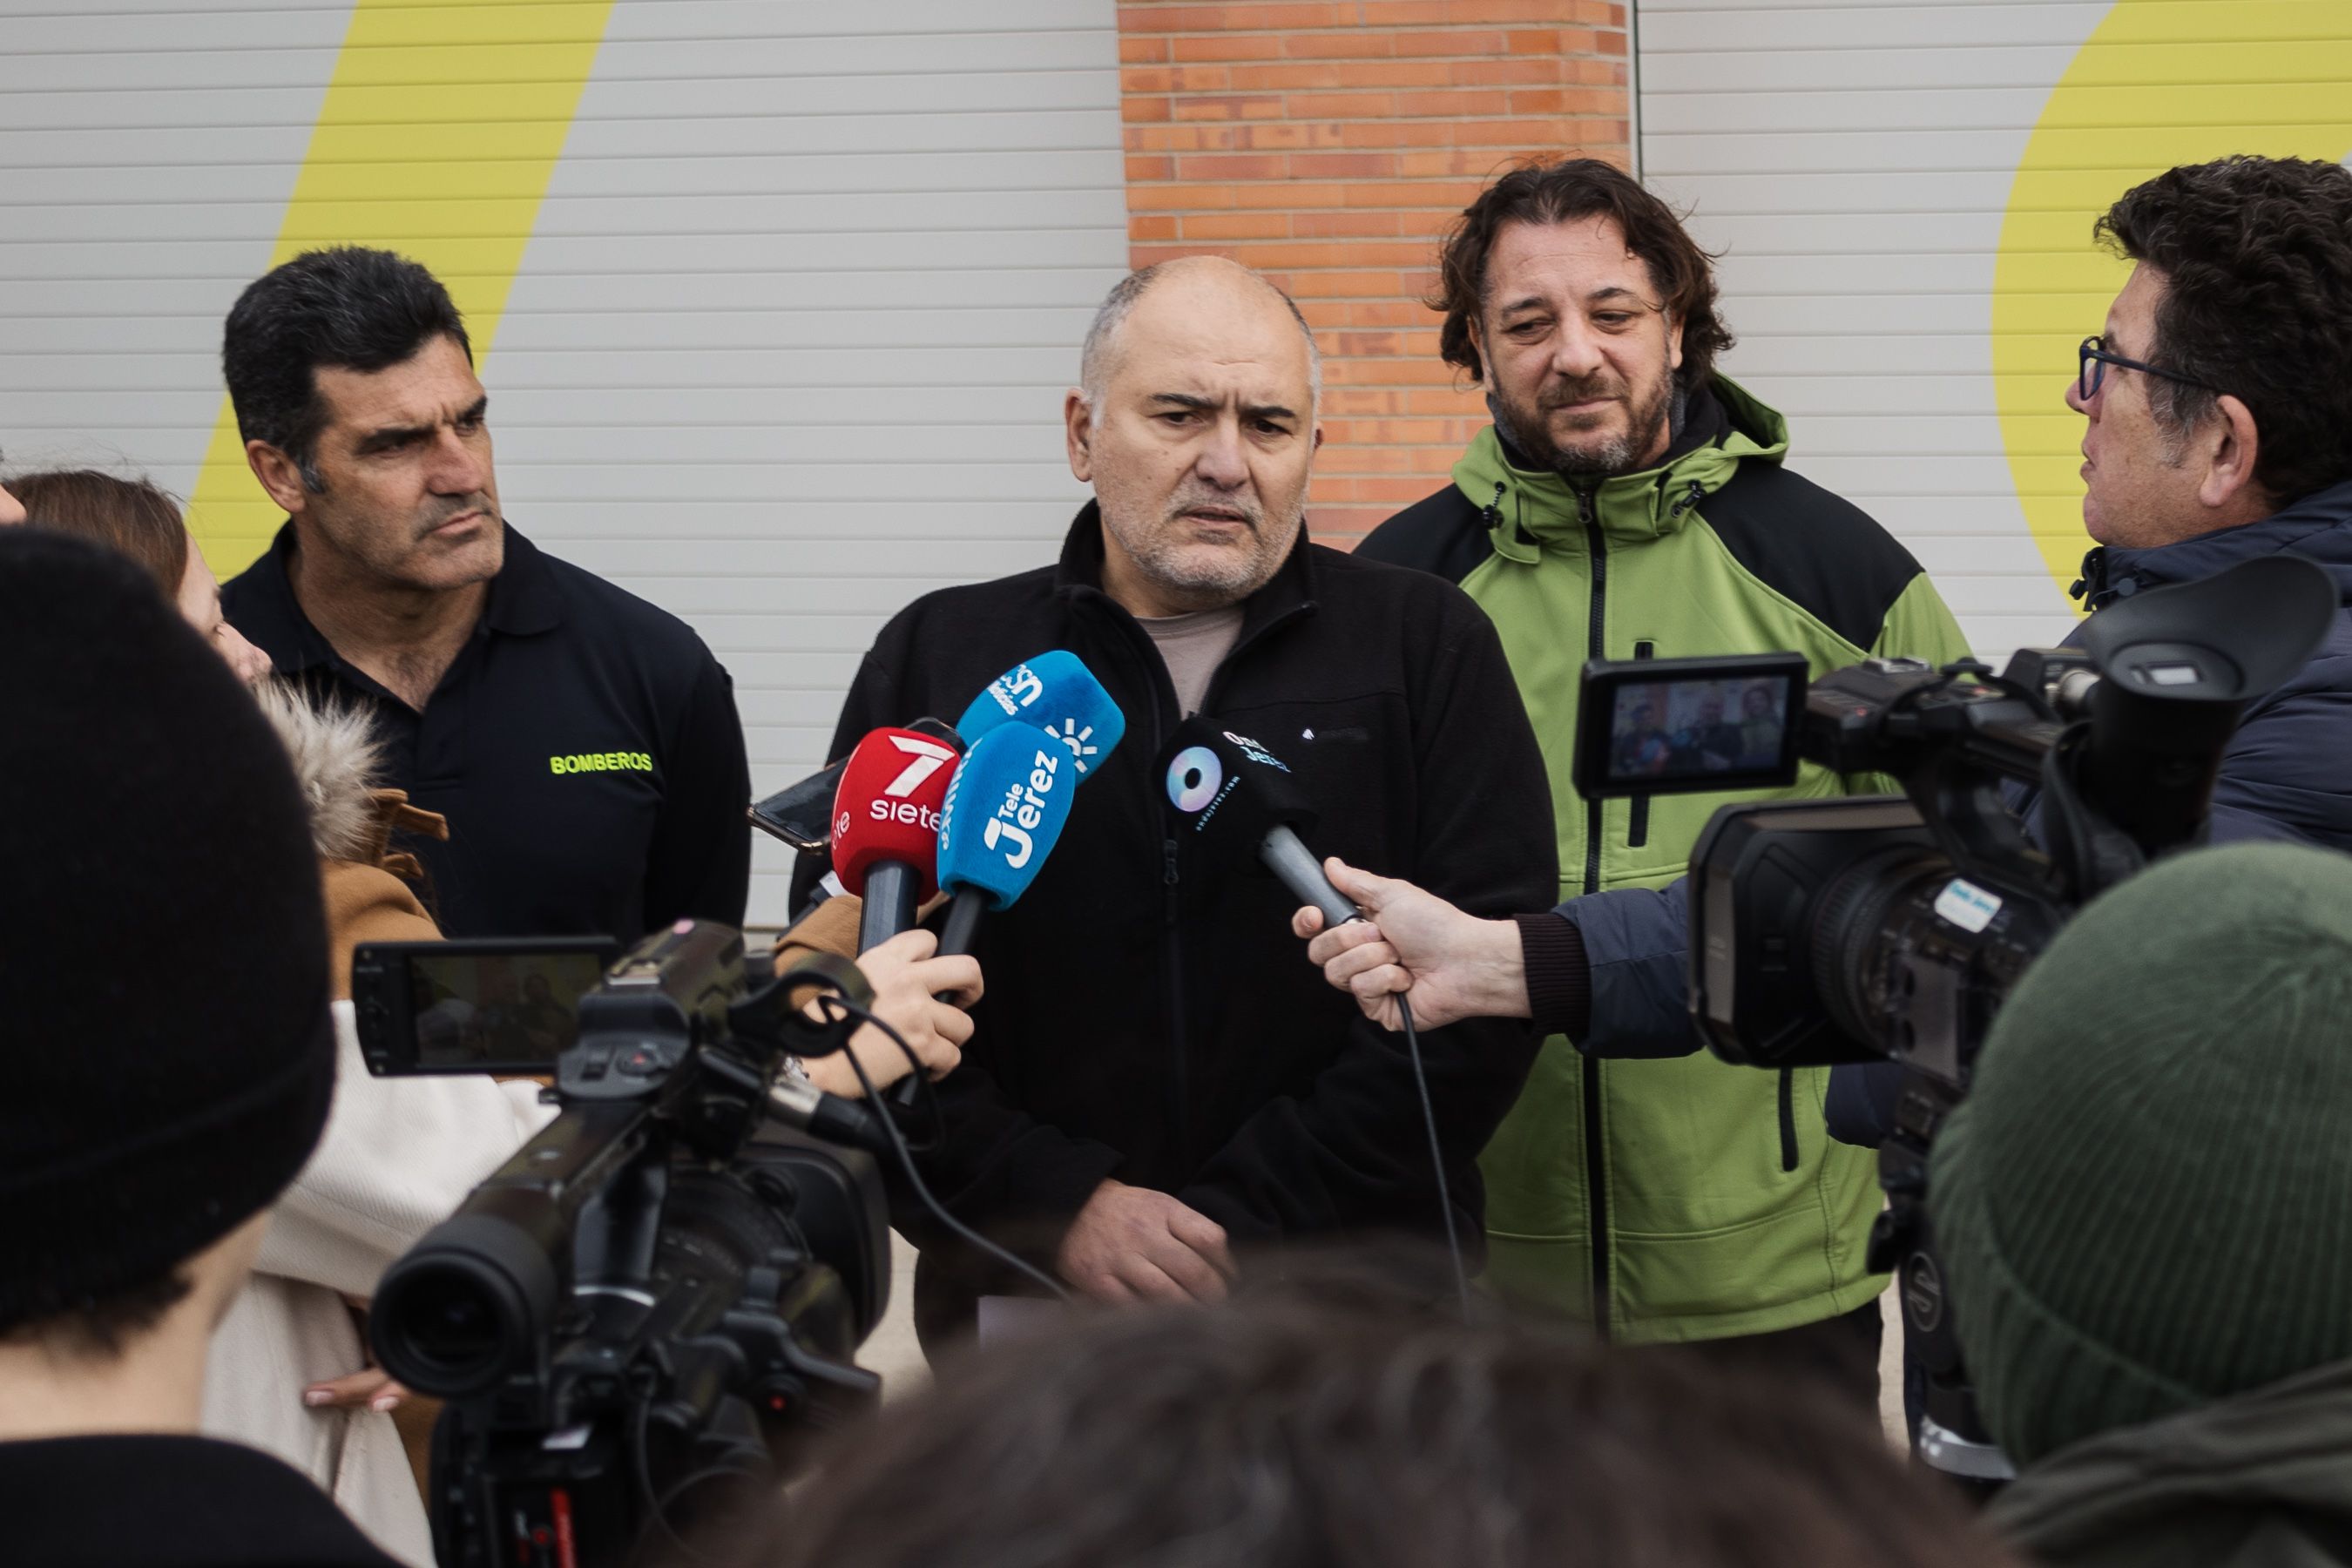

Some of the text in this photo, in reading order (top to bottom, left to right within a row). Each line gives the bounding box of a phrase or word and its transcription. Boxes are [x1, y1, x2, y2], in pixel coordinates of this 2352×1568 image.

[550, 751, 653, 774] BOMBEROS
[884, 734, 956, 798] 7
[983, 750, 1058, 869] Jerez
[997, 783, 1024, 818] Tele
